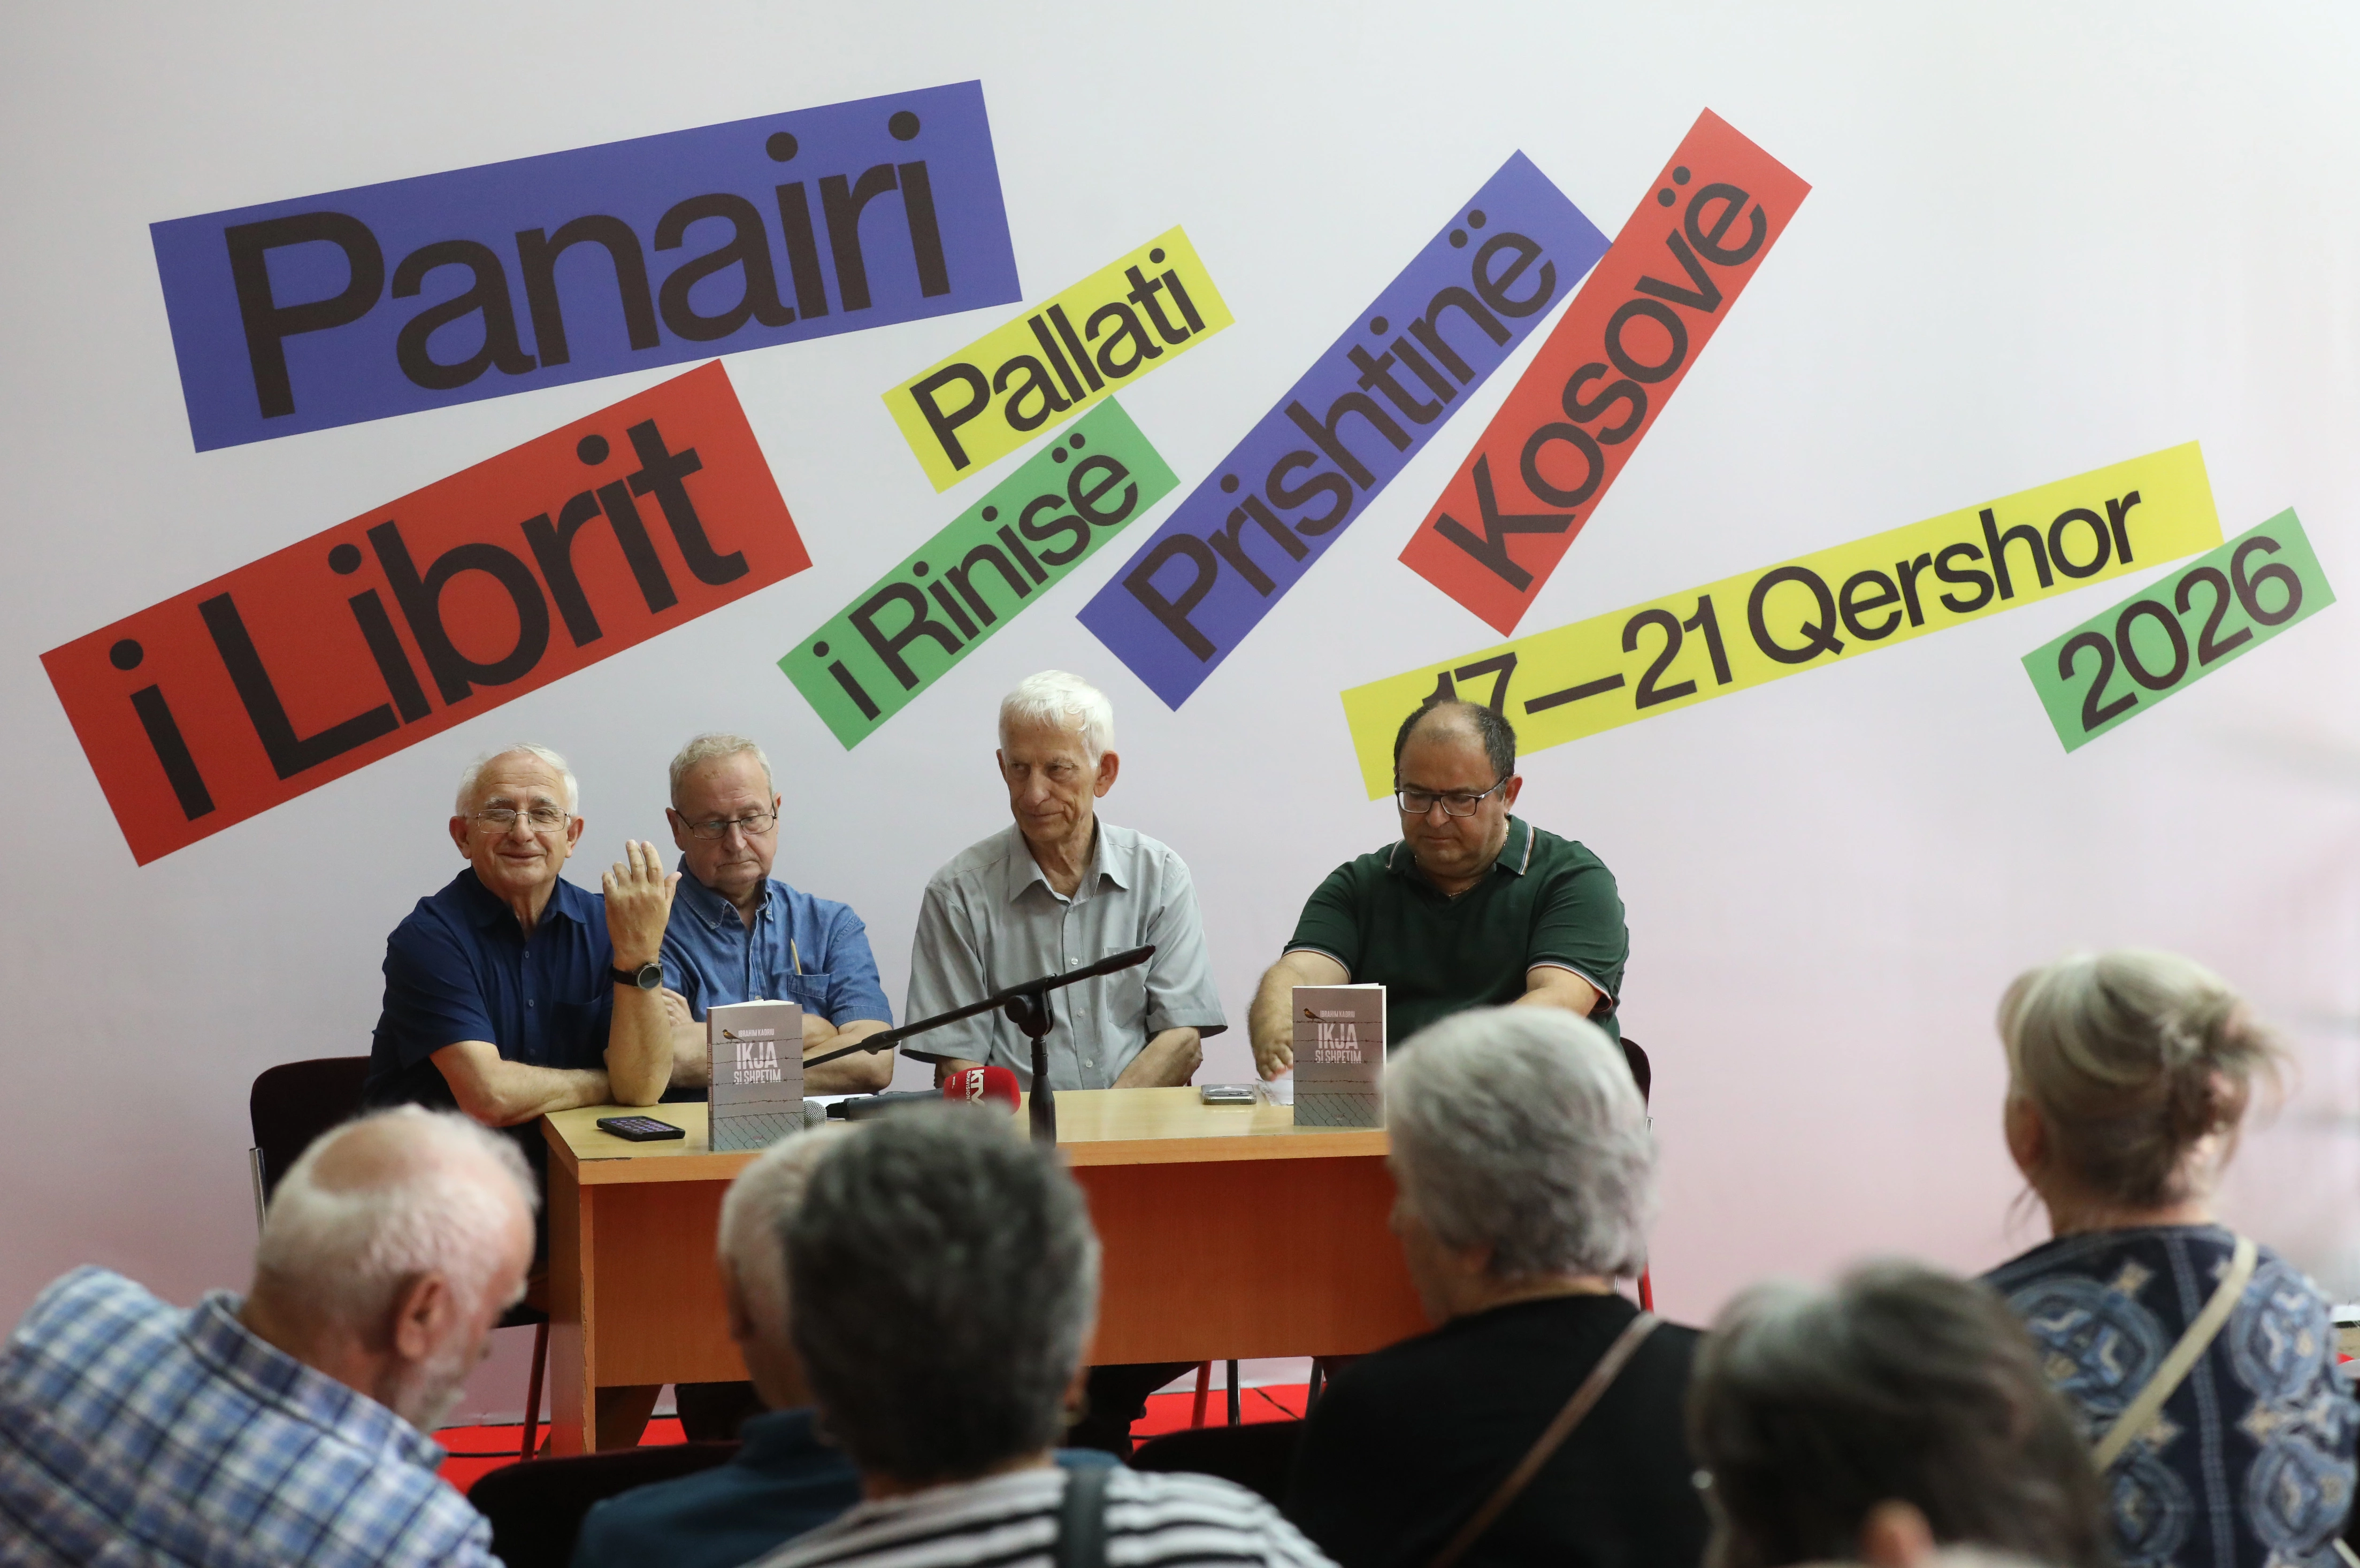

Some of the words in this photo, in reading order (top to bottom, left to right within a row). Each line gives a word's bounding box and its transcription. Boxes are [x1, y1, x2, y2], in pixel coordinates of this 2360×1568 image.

[224, 111, 950, 420] Panairi
[910, 249, 1205, 471] Pallati
[1122, 210, 1556, 663] Prishtinë
[1434, 168, 1766, 591] Kosovë
[110, 639, 216, 822] i
[198, 419, 749, 780] Librit
[813, 641, 881, 721] i
[848, 433, 1138, 691] Rinisë
[1748, 491, 2141, 664] Qershor
[2059, 536, 2303, 732] 2026
[734, 1071, 742, 1085] SI
[744, 1069, 781, 1084] SHPETIM
[736, 1041, 778, 1070] IKJA
[738, 1029, 757, 1037] IBRAHIM
[757, 1028, 775, 1036] KADRIU
[1315, 1050, 1324, 1063] SI
[1325, 1050, 1361, 1064] SHPETIM
[1317, 1023, 1358, 1049] IKJA
